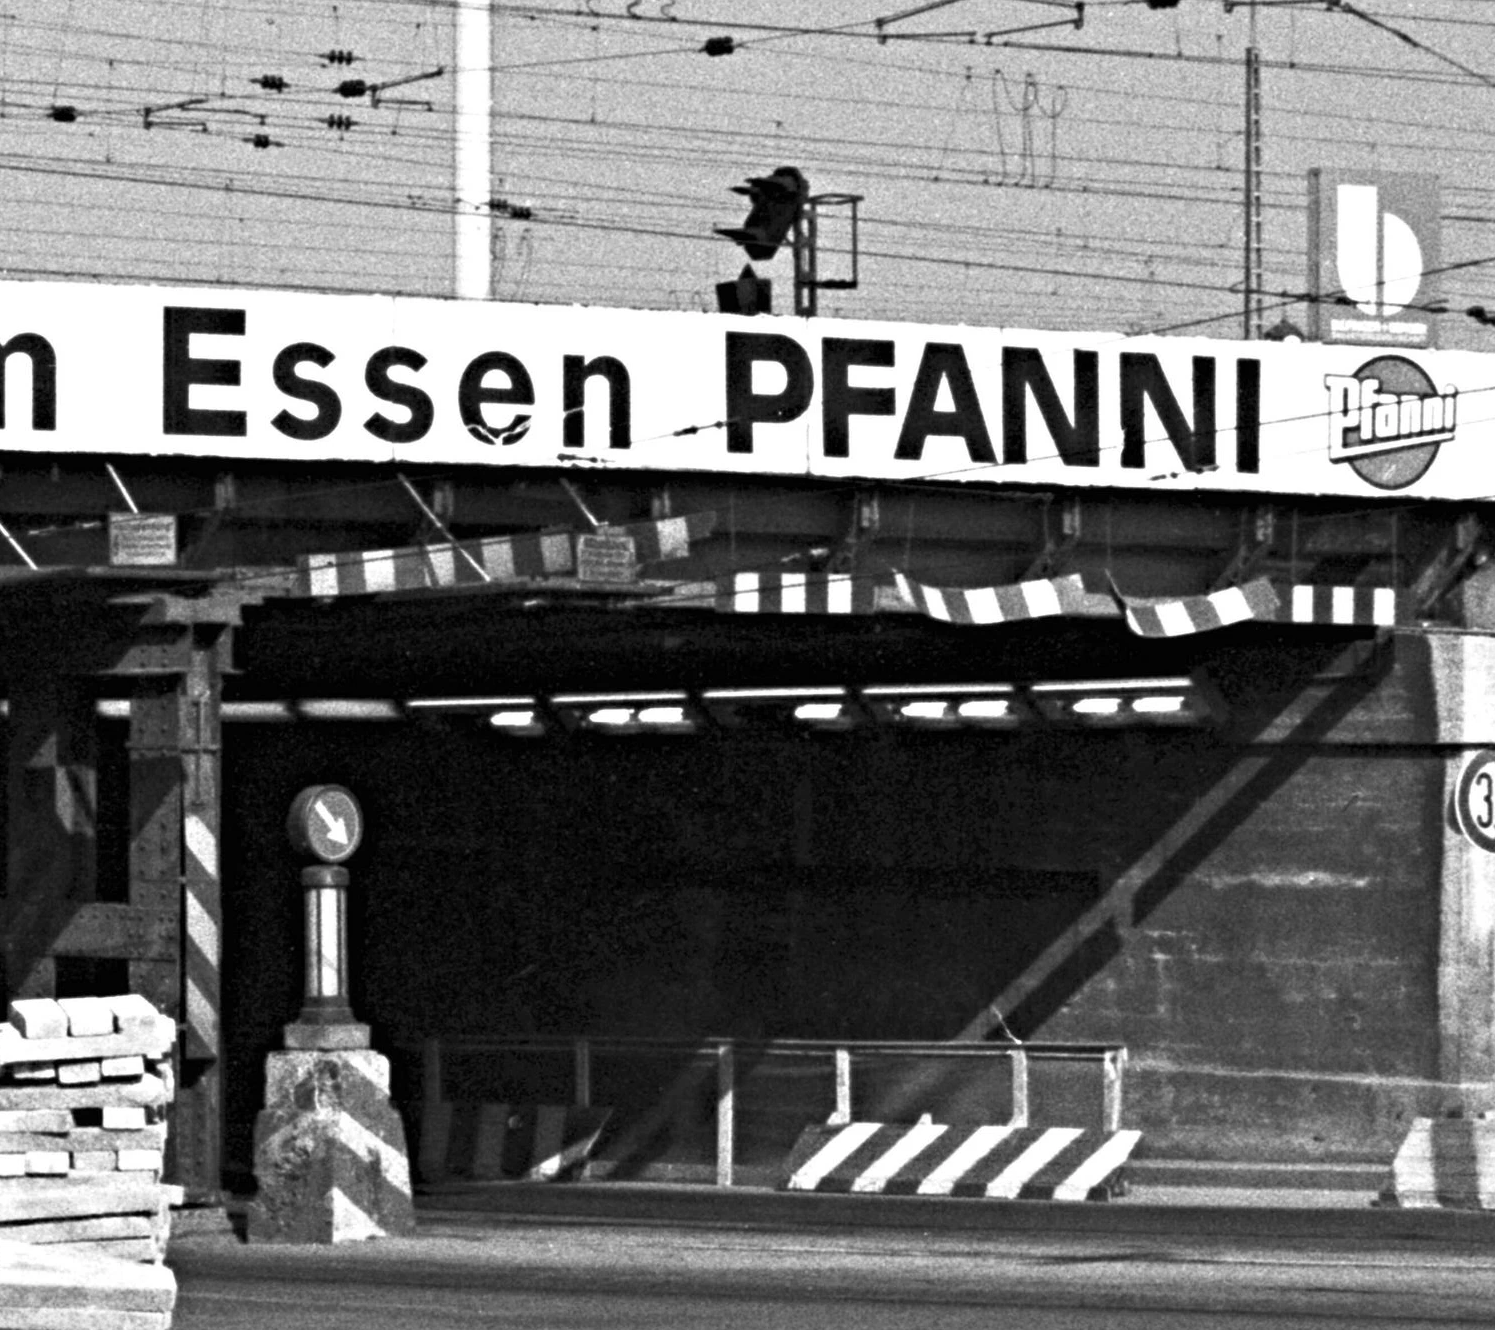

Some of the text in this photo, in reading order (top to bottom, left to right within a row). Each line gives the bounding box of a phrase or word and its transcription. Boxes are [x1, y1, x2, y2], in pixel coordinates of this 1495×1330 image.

[163, 305, 632, 450] Essen
[724, 331, 1261, 475] PFANNI
[1324, 373, 1457, 464] Pfanni
